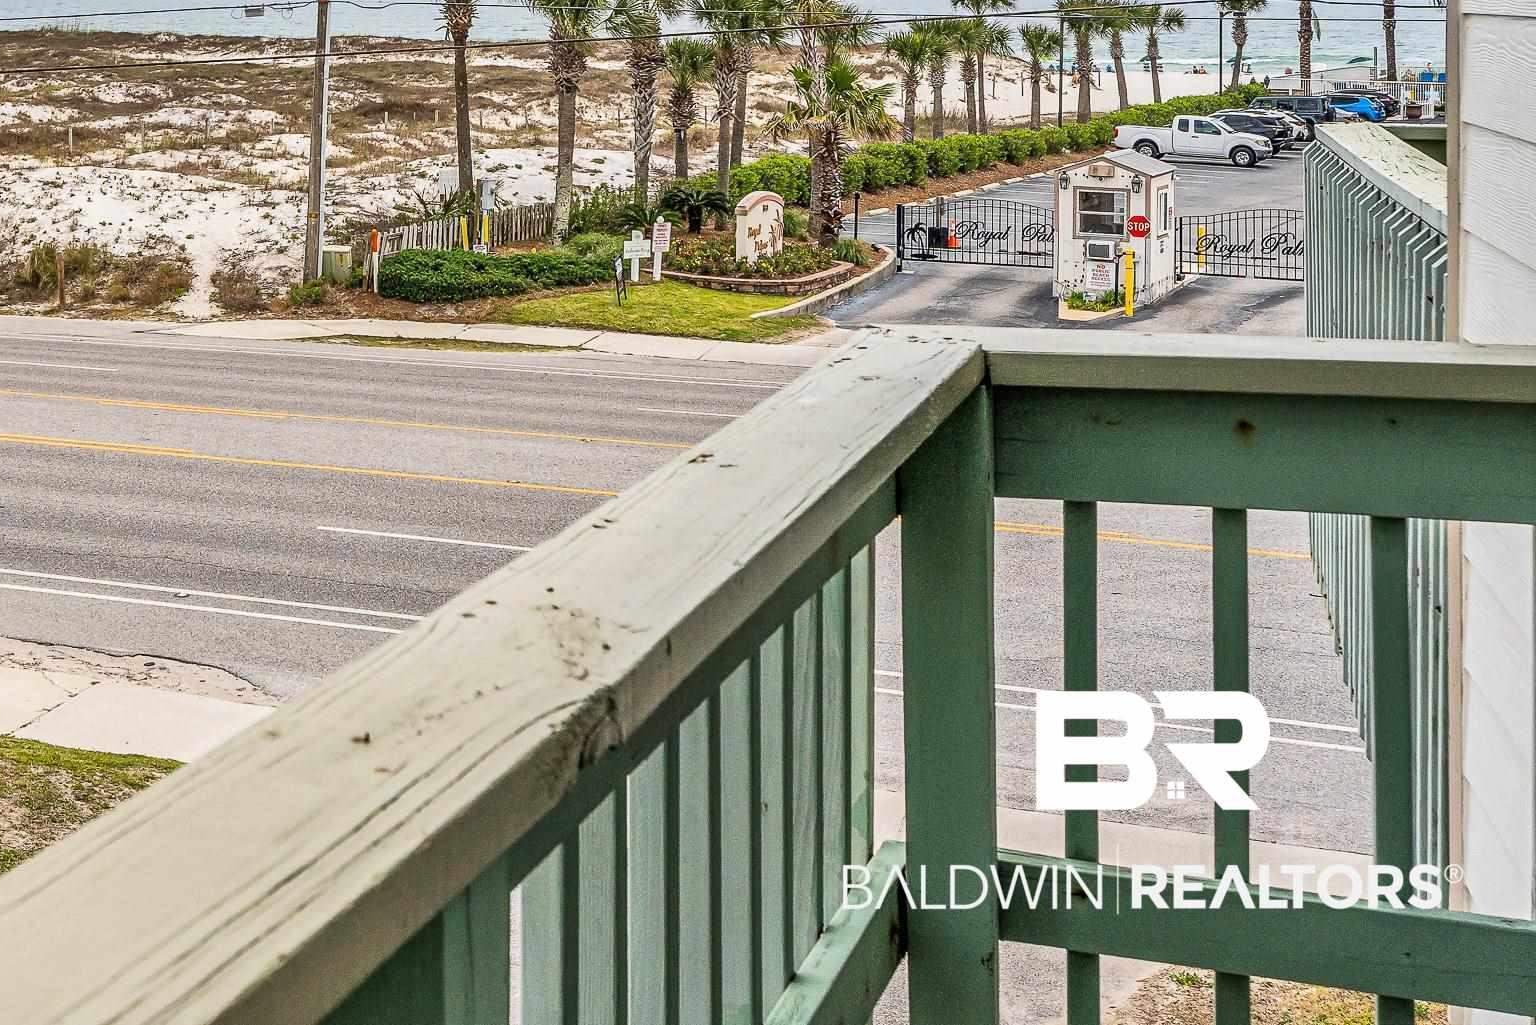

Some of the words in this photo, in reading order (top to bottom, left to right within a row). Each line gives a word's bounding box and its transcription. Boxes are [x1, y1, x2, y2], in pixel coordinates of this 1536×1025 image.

[954, 220, 1011, 248] Royal
[1022, 223, 1055, 243] Pal
[1127, 221, 1150, 232] STOP
[1195, 234, 1255, 261] Royal
